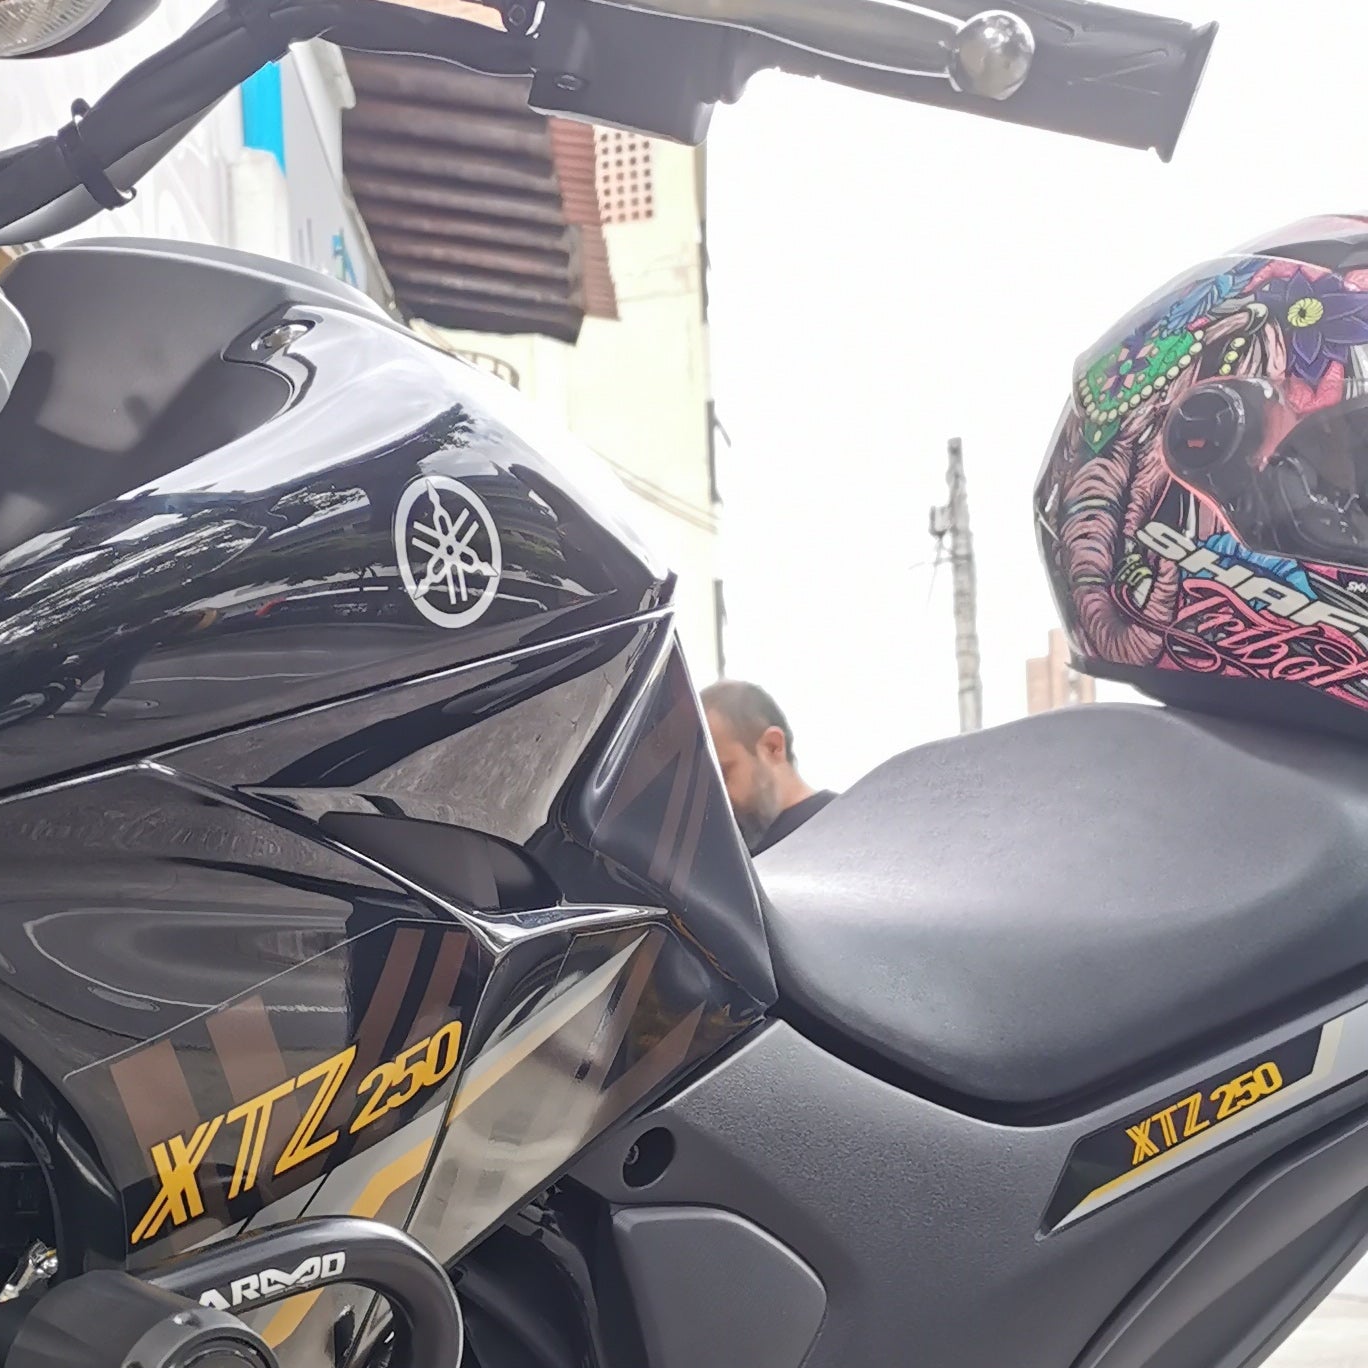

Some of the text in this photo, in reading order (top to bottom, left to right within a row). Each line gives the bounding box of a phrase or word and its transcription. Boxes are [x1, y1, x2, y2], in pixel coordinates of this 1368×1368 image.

[131, 1020, 463, 1245] XTZ 250
[1125, 1061, 1283, 1165] XTZ 250
